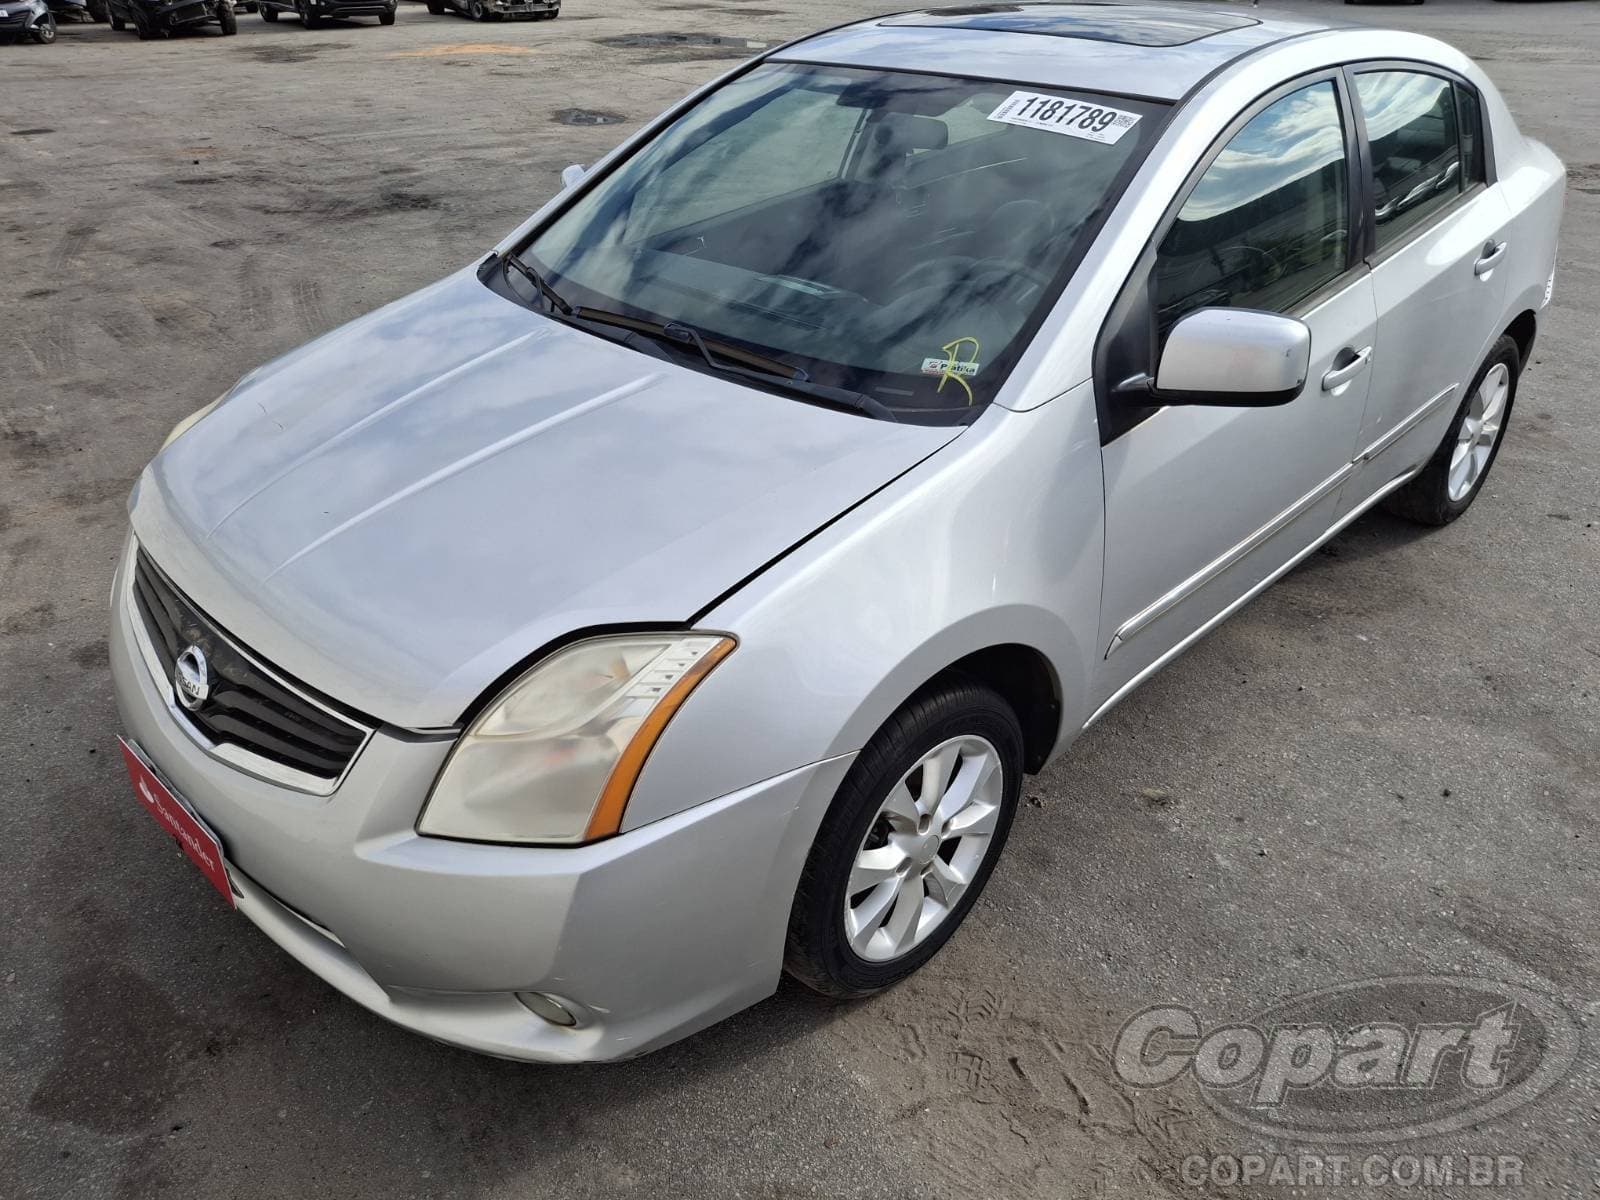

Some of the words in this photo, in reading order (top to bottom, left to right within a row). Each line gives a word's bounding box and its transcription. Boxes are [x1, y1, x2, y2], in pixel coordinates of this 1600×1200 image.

[1017, 96, 1117, 133] 1181789
[940, 363, 976, 373] Patika
[152, 793, 216, 873] Santander
